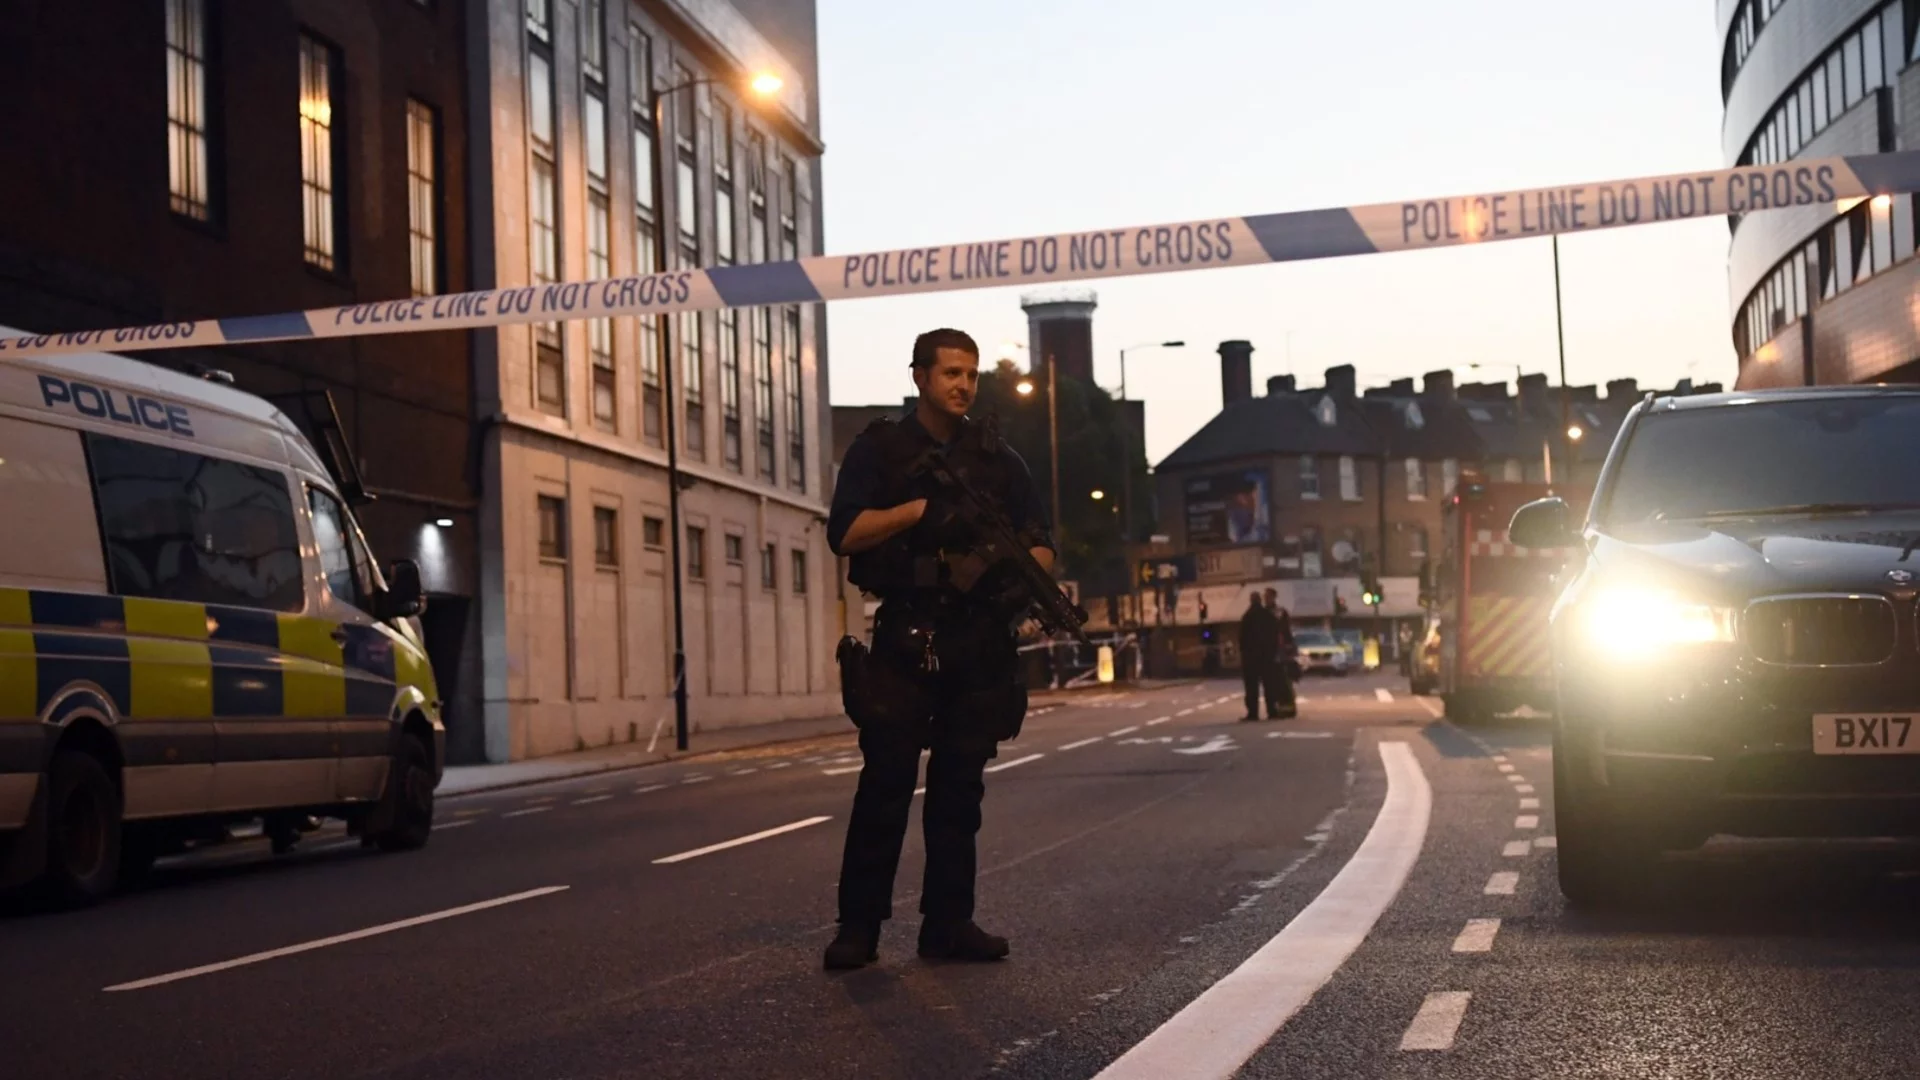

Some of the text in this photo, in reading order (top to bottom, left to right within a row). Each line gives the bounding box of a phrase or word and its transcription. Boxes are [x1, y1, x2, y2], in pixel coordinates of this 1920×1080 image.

[1519, 188, 1586, 233] LINE
[1603, 182, 1640, 226] DO
[1653, 176, 1716, 220] NOT
[1728, 164, 1836, 213] CROSS
[843, 221, 1233, 289] POLICE LINE DO NOT CROSS
[336, 273, 692, 325] POLICE LINE DO NOT CROSS
[37, 373, 196, 438] POLICE
[1834, 717, 1912, 748] BX17
